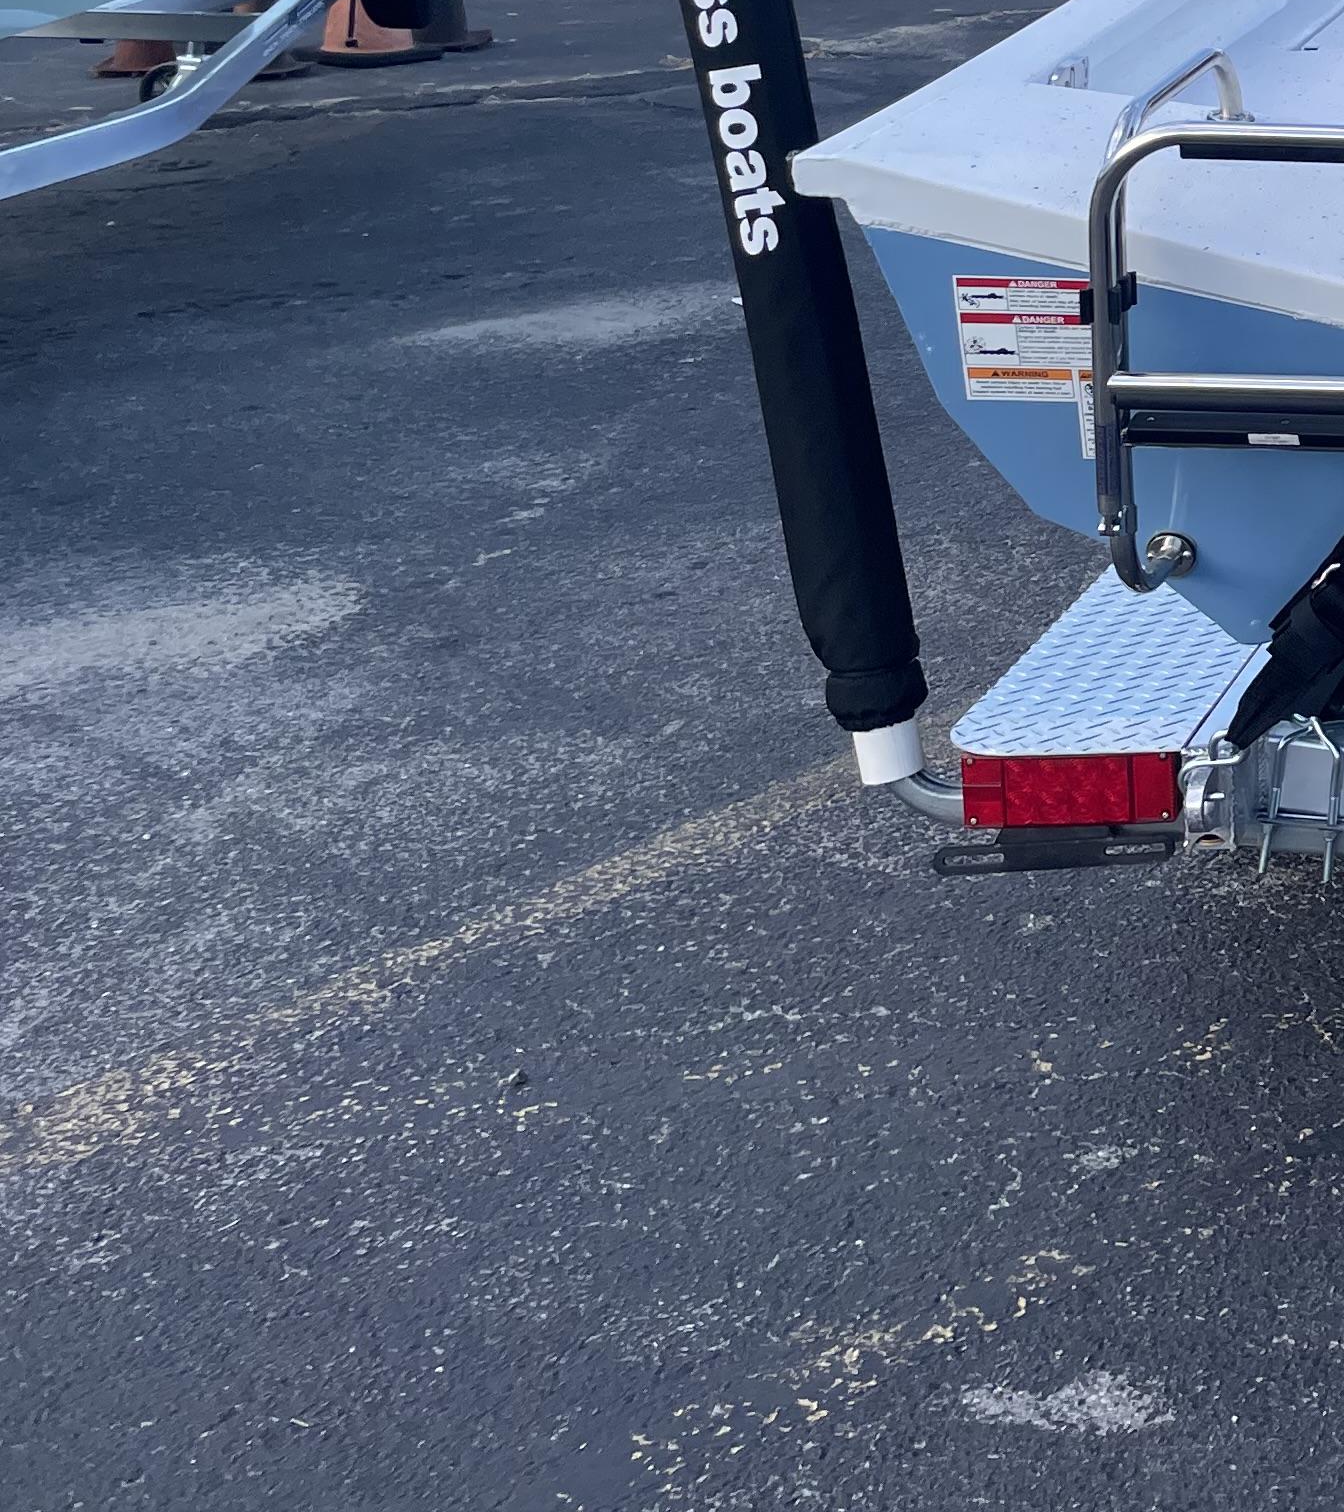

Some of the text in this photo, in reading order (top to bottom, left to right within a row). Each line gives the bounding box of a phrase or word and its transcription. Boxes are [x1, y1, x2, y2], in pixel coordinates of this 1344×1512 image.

[708, 63, 786, 256] boats
[1017, 280, 1058, 288] DANGER
[1022, 316, 1065, 324] DANGER
[1001, 370, 1049, 378] WARNING
